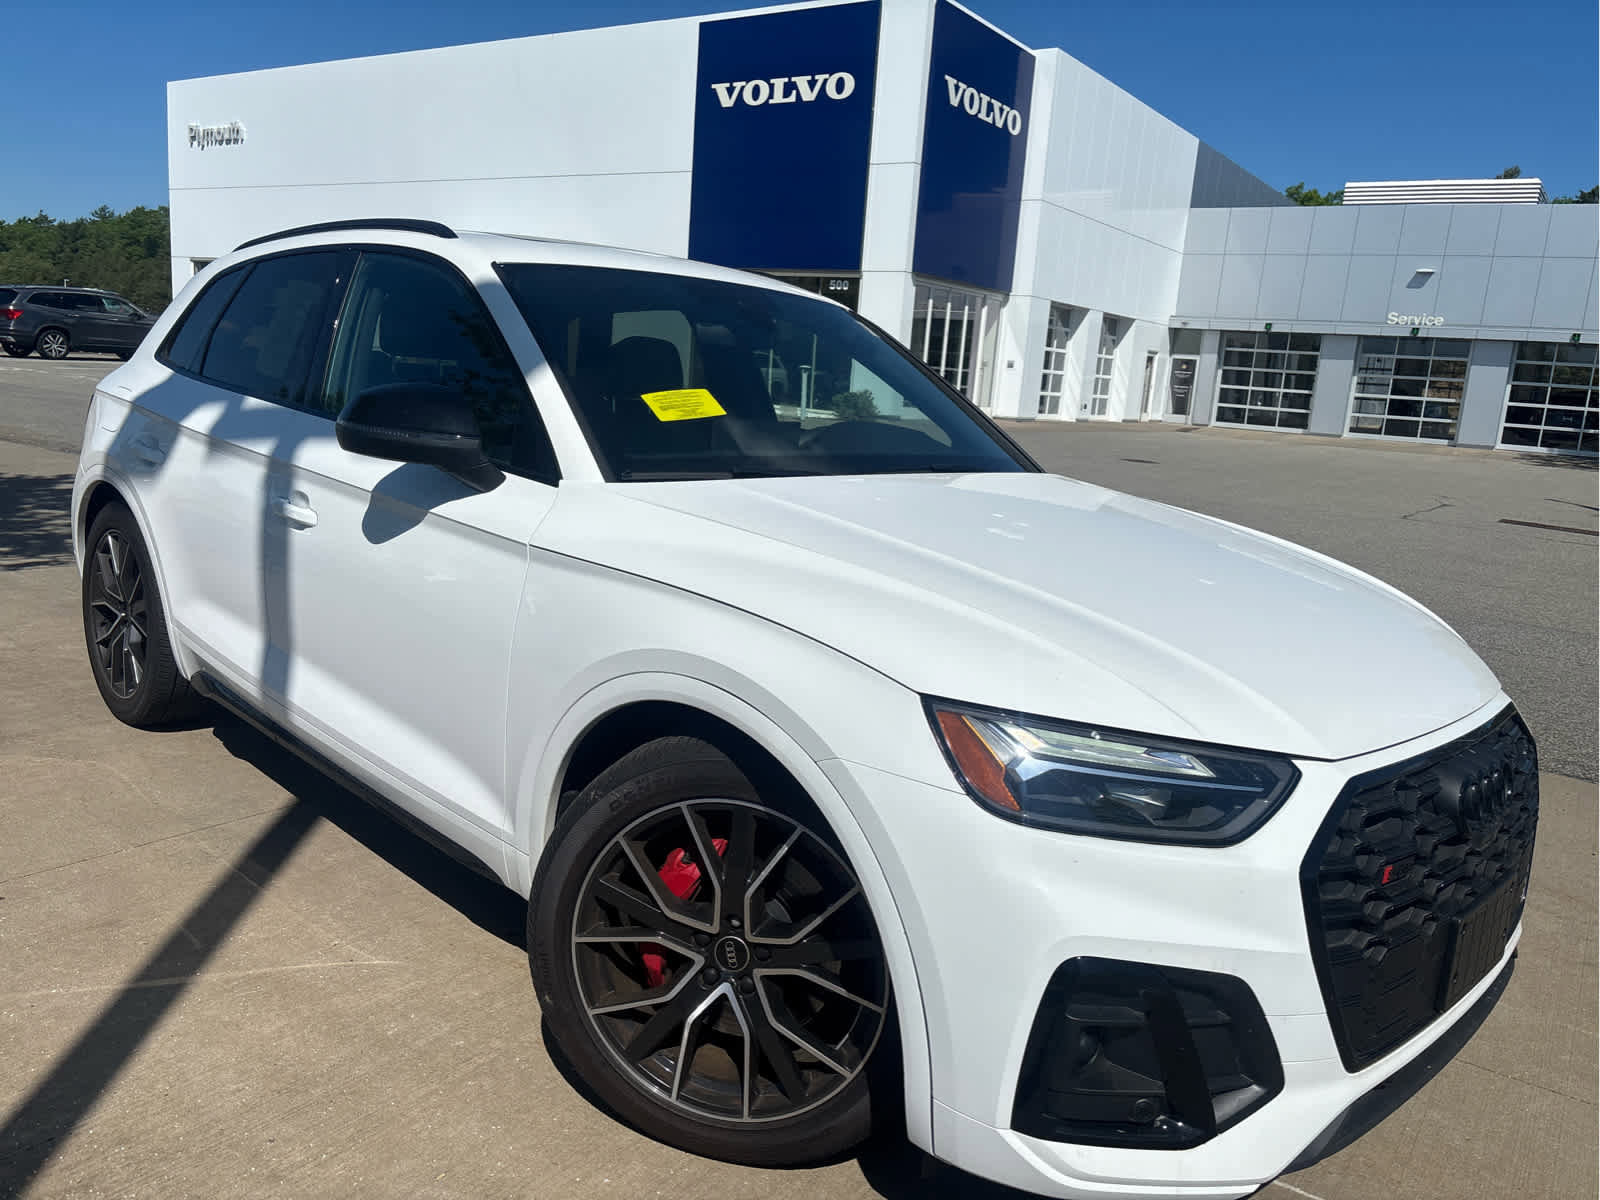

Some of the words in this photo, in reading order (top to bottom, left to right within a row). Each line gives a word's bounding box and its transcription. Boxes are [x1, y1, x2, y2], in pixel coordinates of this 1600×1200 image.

[711, 71, 856, 108] VOLVO
[944, 74, 1022, 136] VOLVO
[187, 121, 246, 151] Plymouth
[829, 279, 849, 291] 500
[1386, 311, 1445, 326] Service
